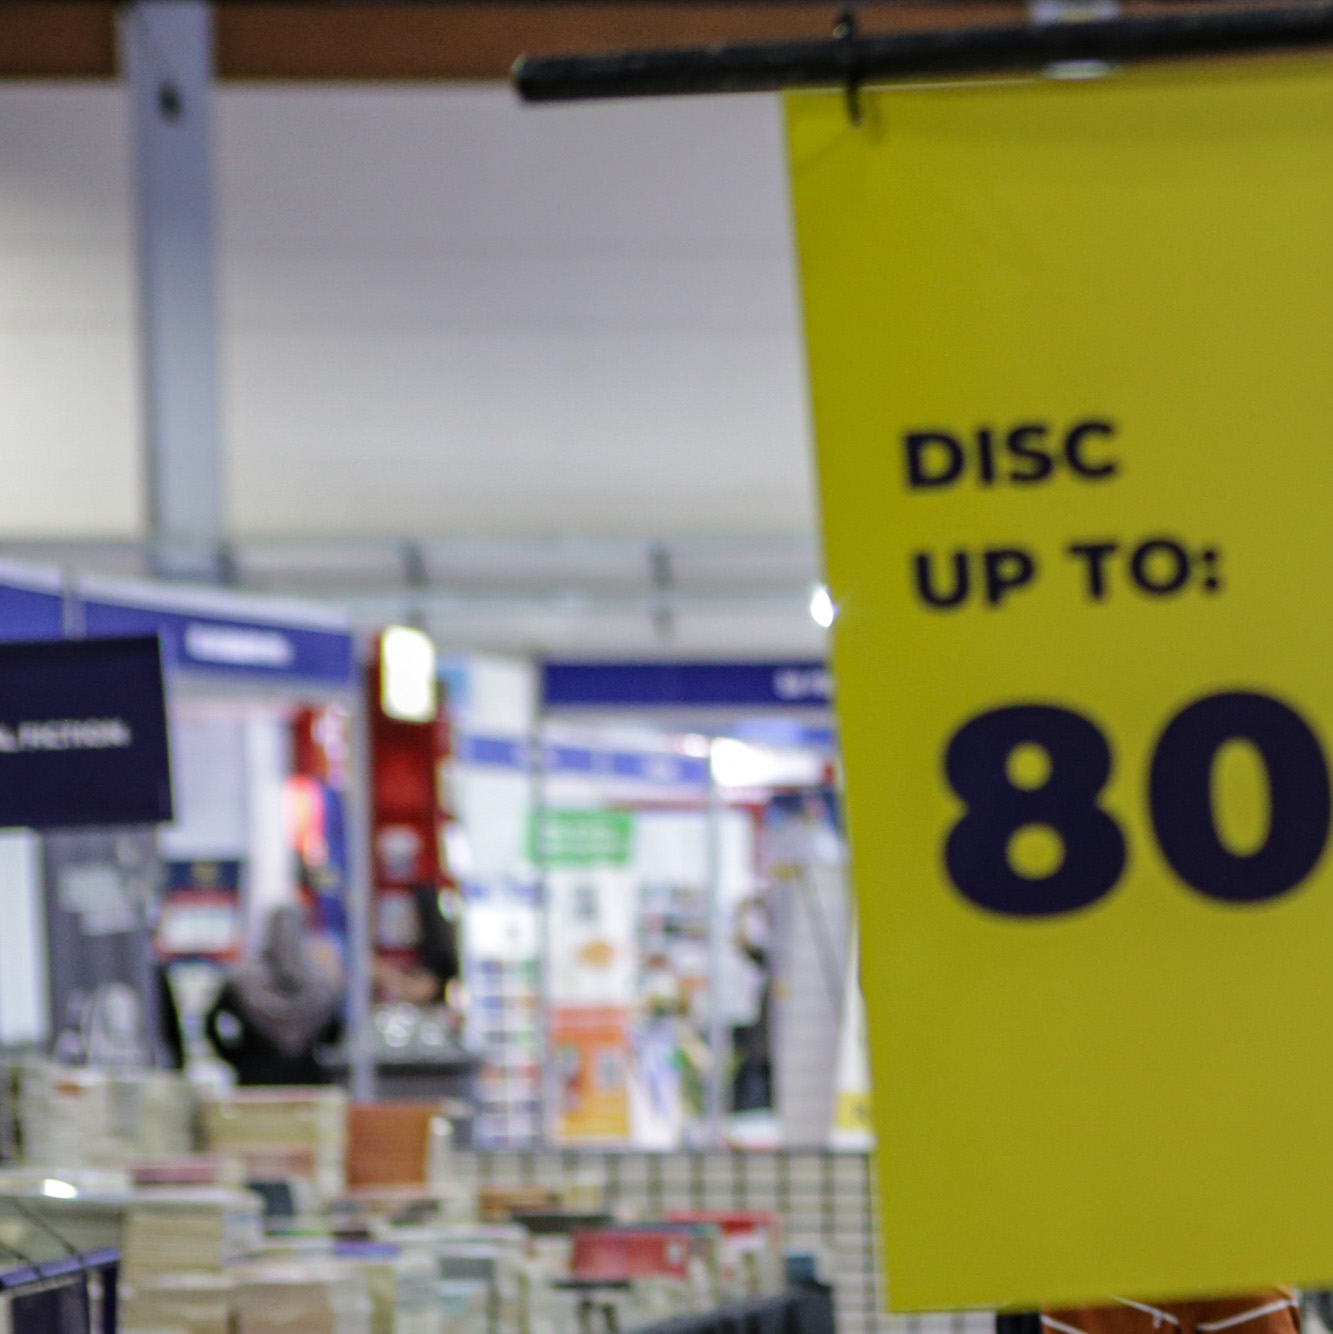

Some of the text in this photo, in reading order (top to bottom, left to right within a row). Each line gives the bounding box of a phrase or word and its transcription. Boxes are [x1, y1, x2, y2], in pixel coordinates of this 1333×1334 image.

[900, 416, 1122, 494] DISC
[910, 534, 1224, 614] UP TO:
